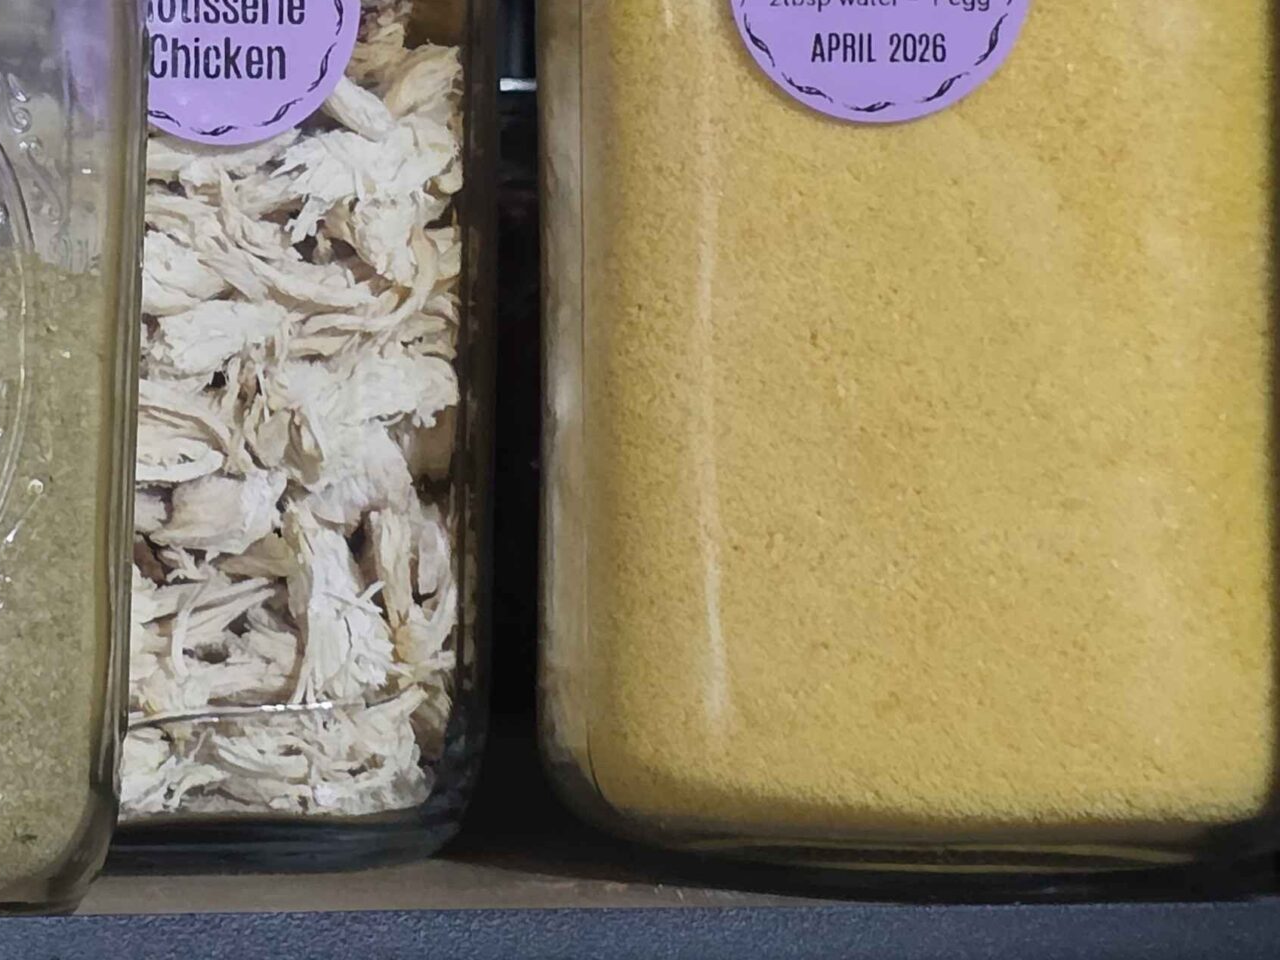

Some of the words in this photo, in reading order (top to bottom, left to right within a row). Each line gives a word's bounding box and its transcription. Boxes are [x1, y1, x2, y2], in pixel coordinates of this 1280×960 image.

[149, 33, 287, 81] Chicken
[811, 32, 877, 63] APRIL
[889, 32, 947, 63] 2026
